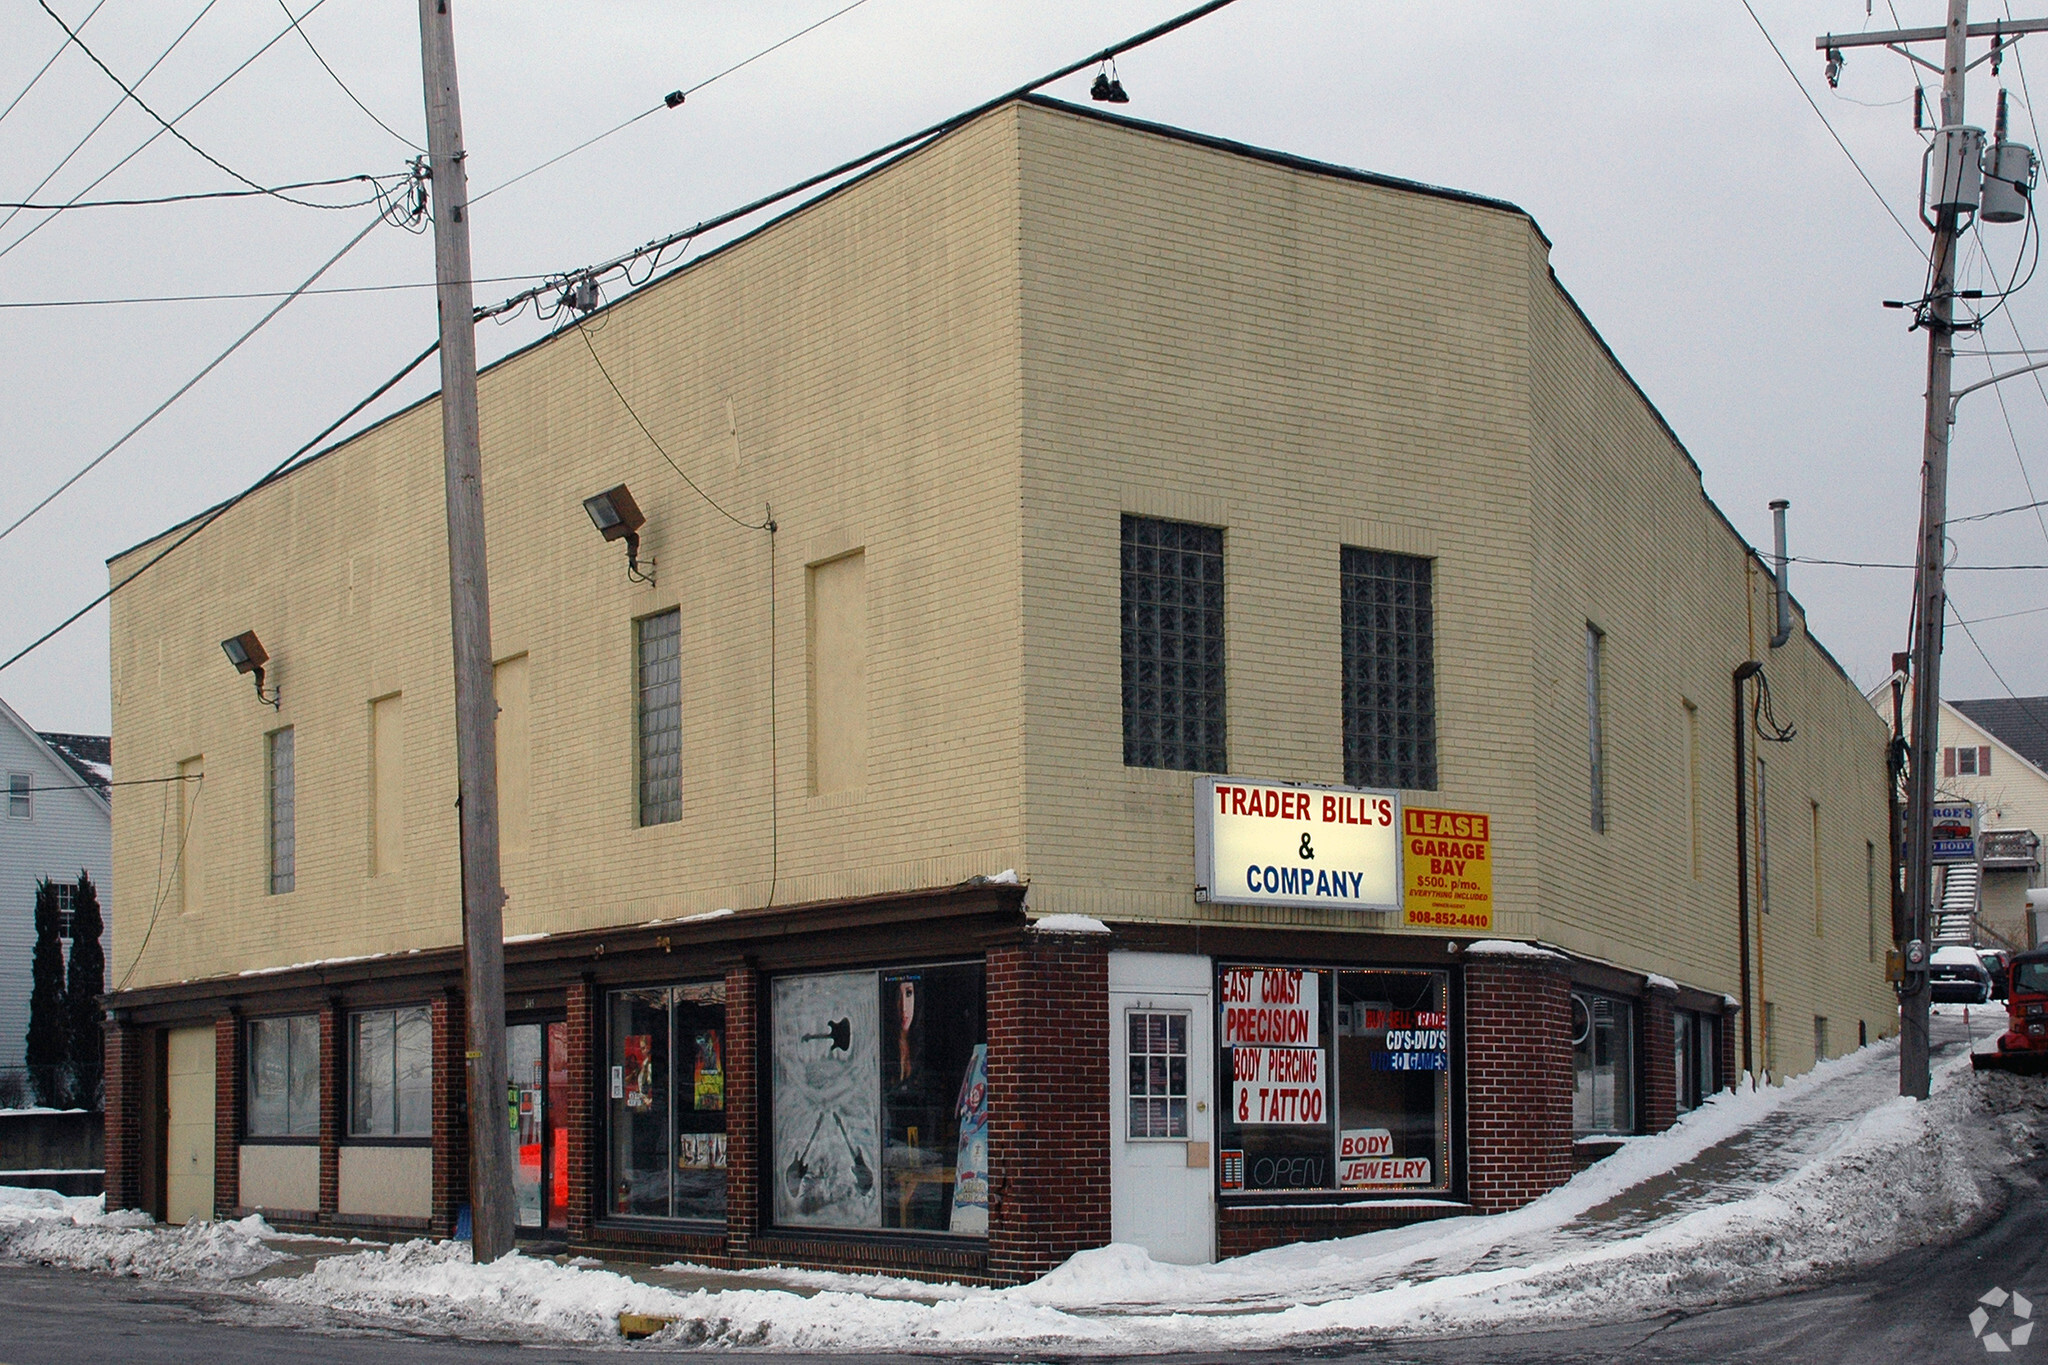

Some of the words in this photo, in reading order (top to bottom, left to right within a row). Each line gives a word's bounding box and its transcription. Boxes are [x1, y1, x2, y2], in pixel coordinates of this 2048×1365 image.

[1216, 786, 1311, 820] TRADER
[1322, 795, 1393, 827] BILL'S
[1409, 812, 1485, 839] LEASE
[1299, 832, 1315, 860] &
[1410, 838, 1485, 861] GARAGE
[1940, 841, 1971, 851] BODY
[1430, 858, 1467, 877] BAY
[1246, 864, 1364, 899] COMPANY
[1417, 875, 1448, 888] $500.
[1409, 888, 1453, 899] EVERYTHING
[1454, 891, 1488, 901] INCLUDED
[1409, 910, 1488, 928] 908-852-4410
[1222, 968, 1254, 1003] EAST
[1262, 969, 1303, 1004] COAST
[1226, 1008, 1309, 1043] PRECISION
[1386, 1030, 1446, 1050] CD'S-DVD'S
[1234, 1049, 1260, 1082] BODY
[1268, 1050, 1317, 1083] PIERCING
[1239, 1087, 1249, 1121] &
[1259, 1088, 1322, 1122] TATTOO
[1341, 1135, 1390, 1156] BODY
[1253, 1157, 1324, 1186] OPEN
[1341, 1160, 1427, 1181] JEWELRY
